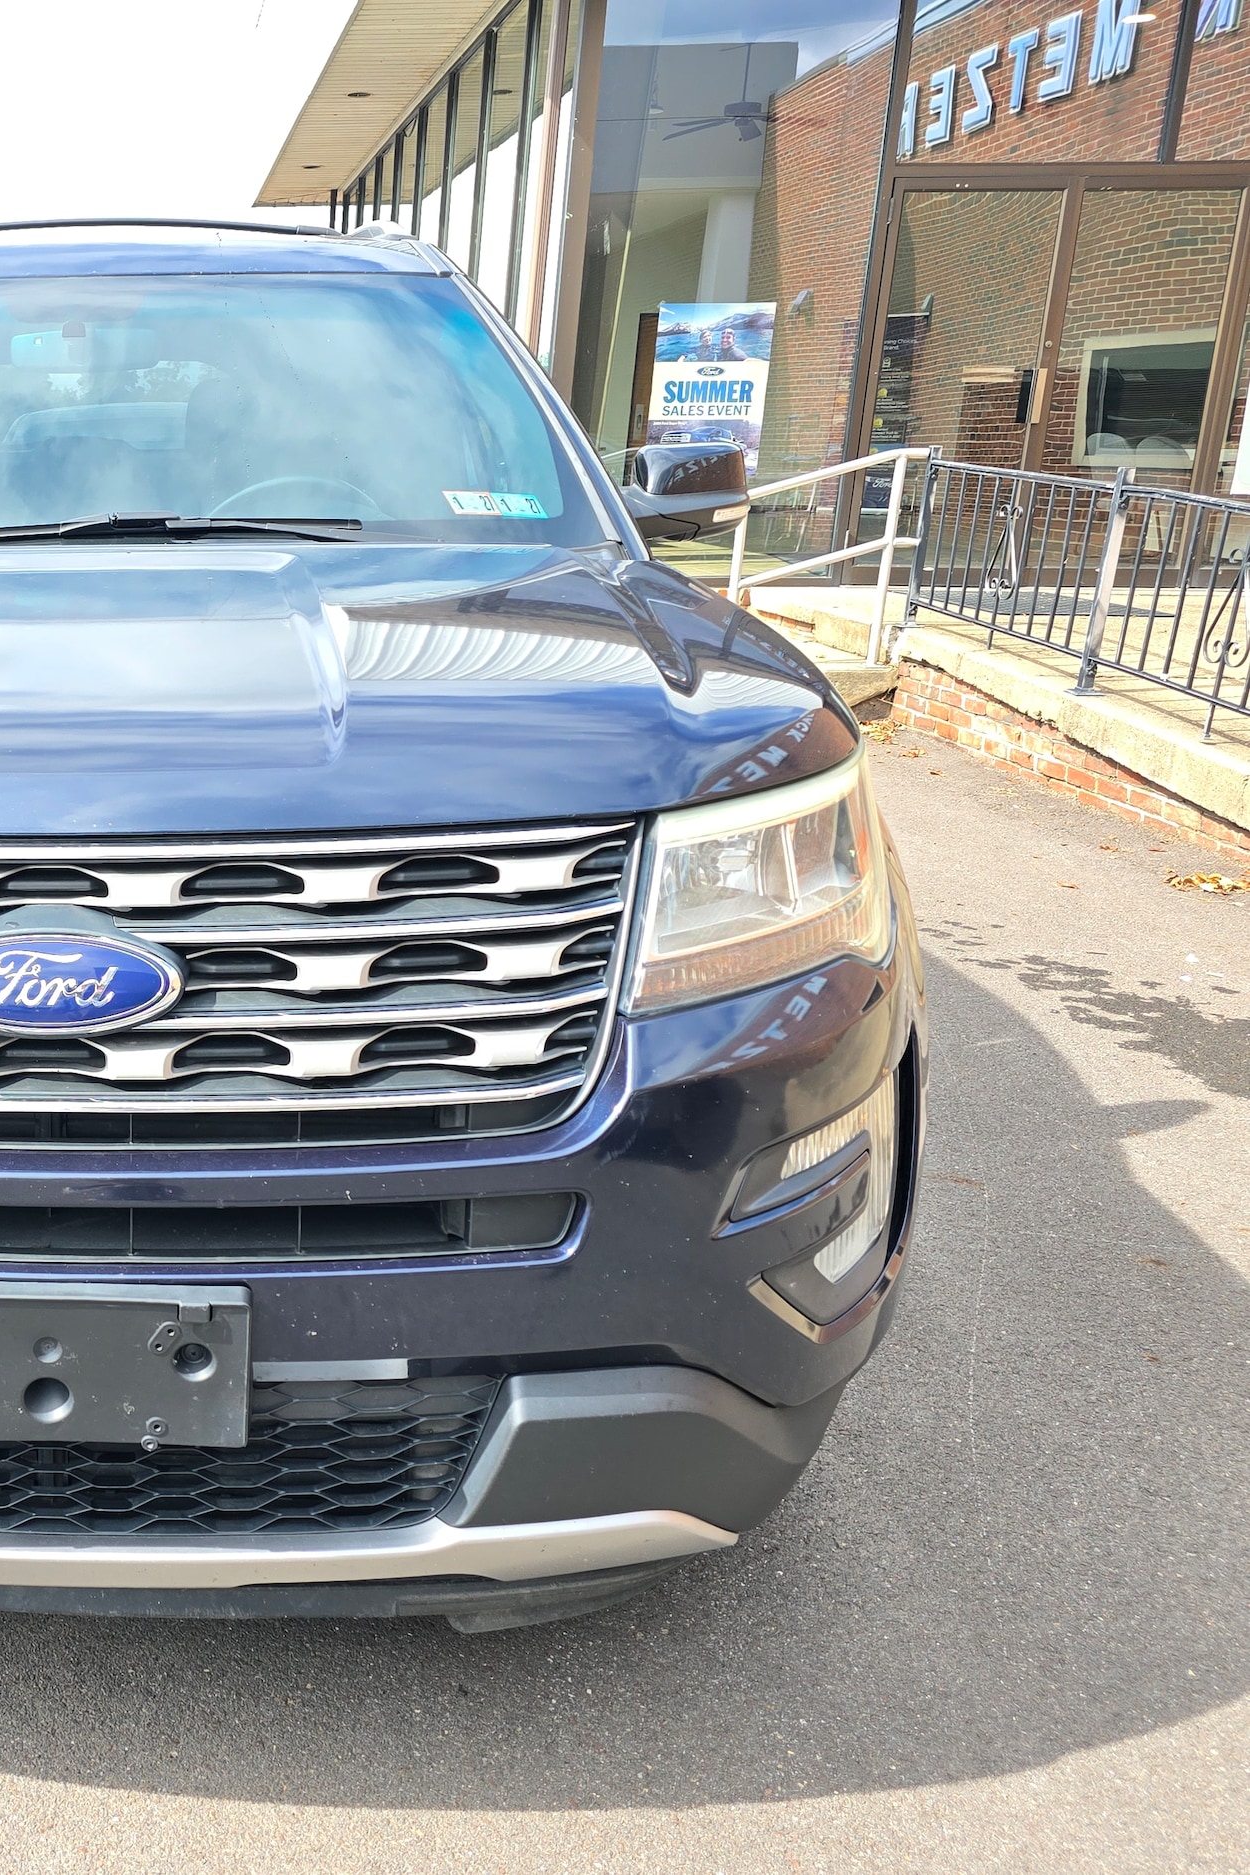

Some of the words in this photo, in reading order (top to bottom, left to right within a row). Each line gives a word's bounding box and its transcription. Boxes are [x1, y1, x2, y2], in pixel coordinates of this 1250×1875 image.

[663, 381, 754, 403] SUMMER
[662, 405, 704, 416] SALES
[707, 405, 751, 416] EVENT
